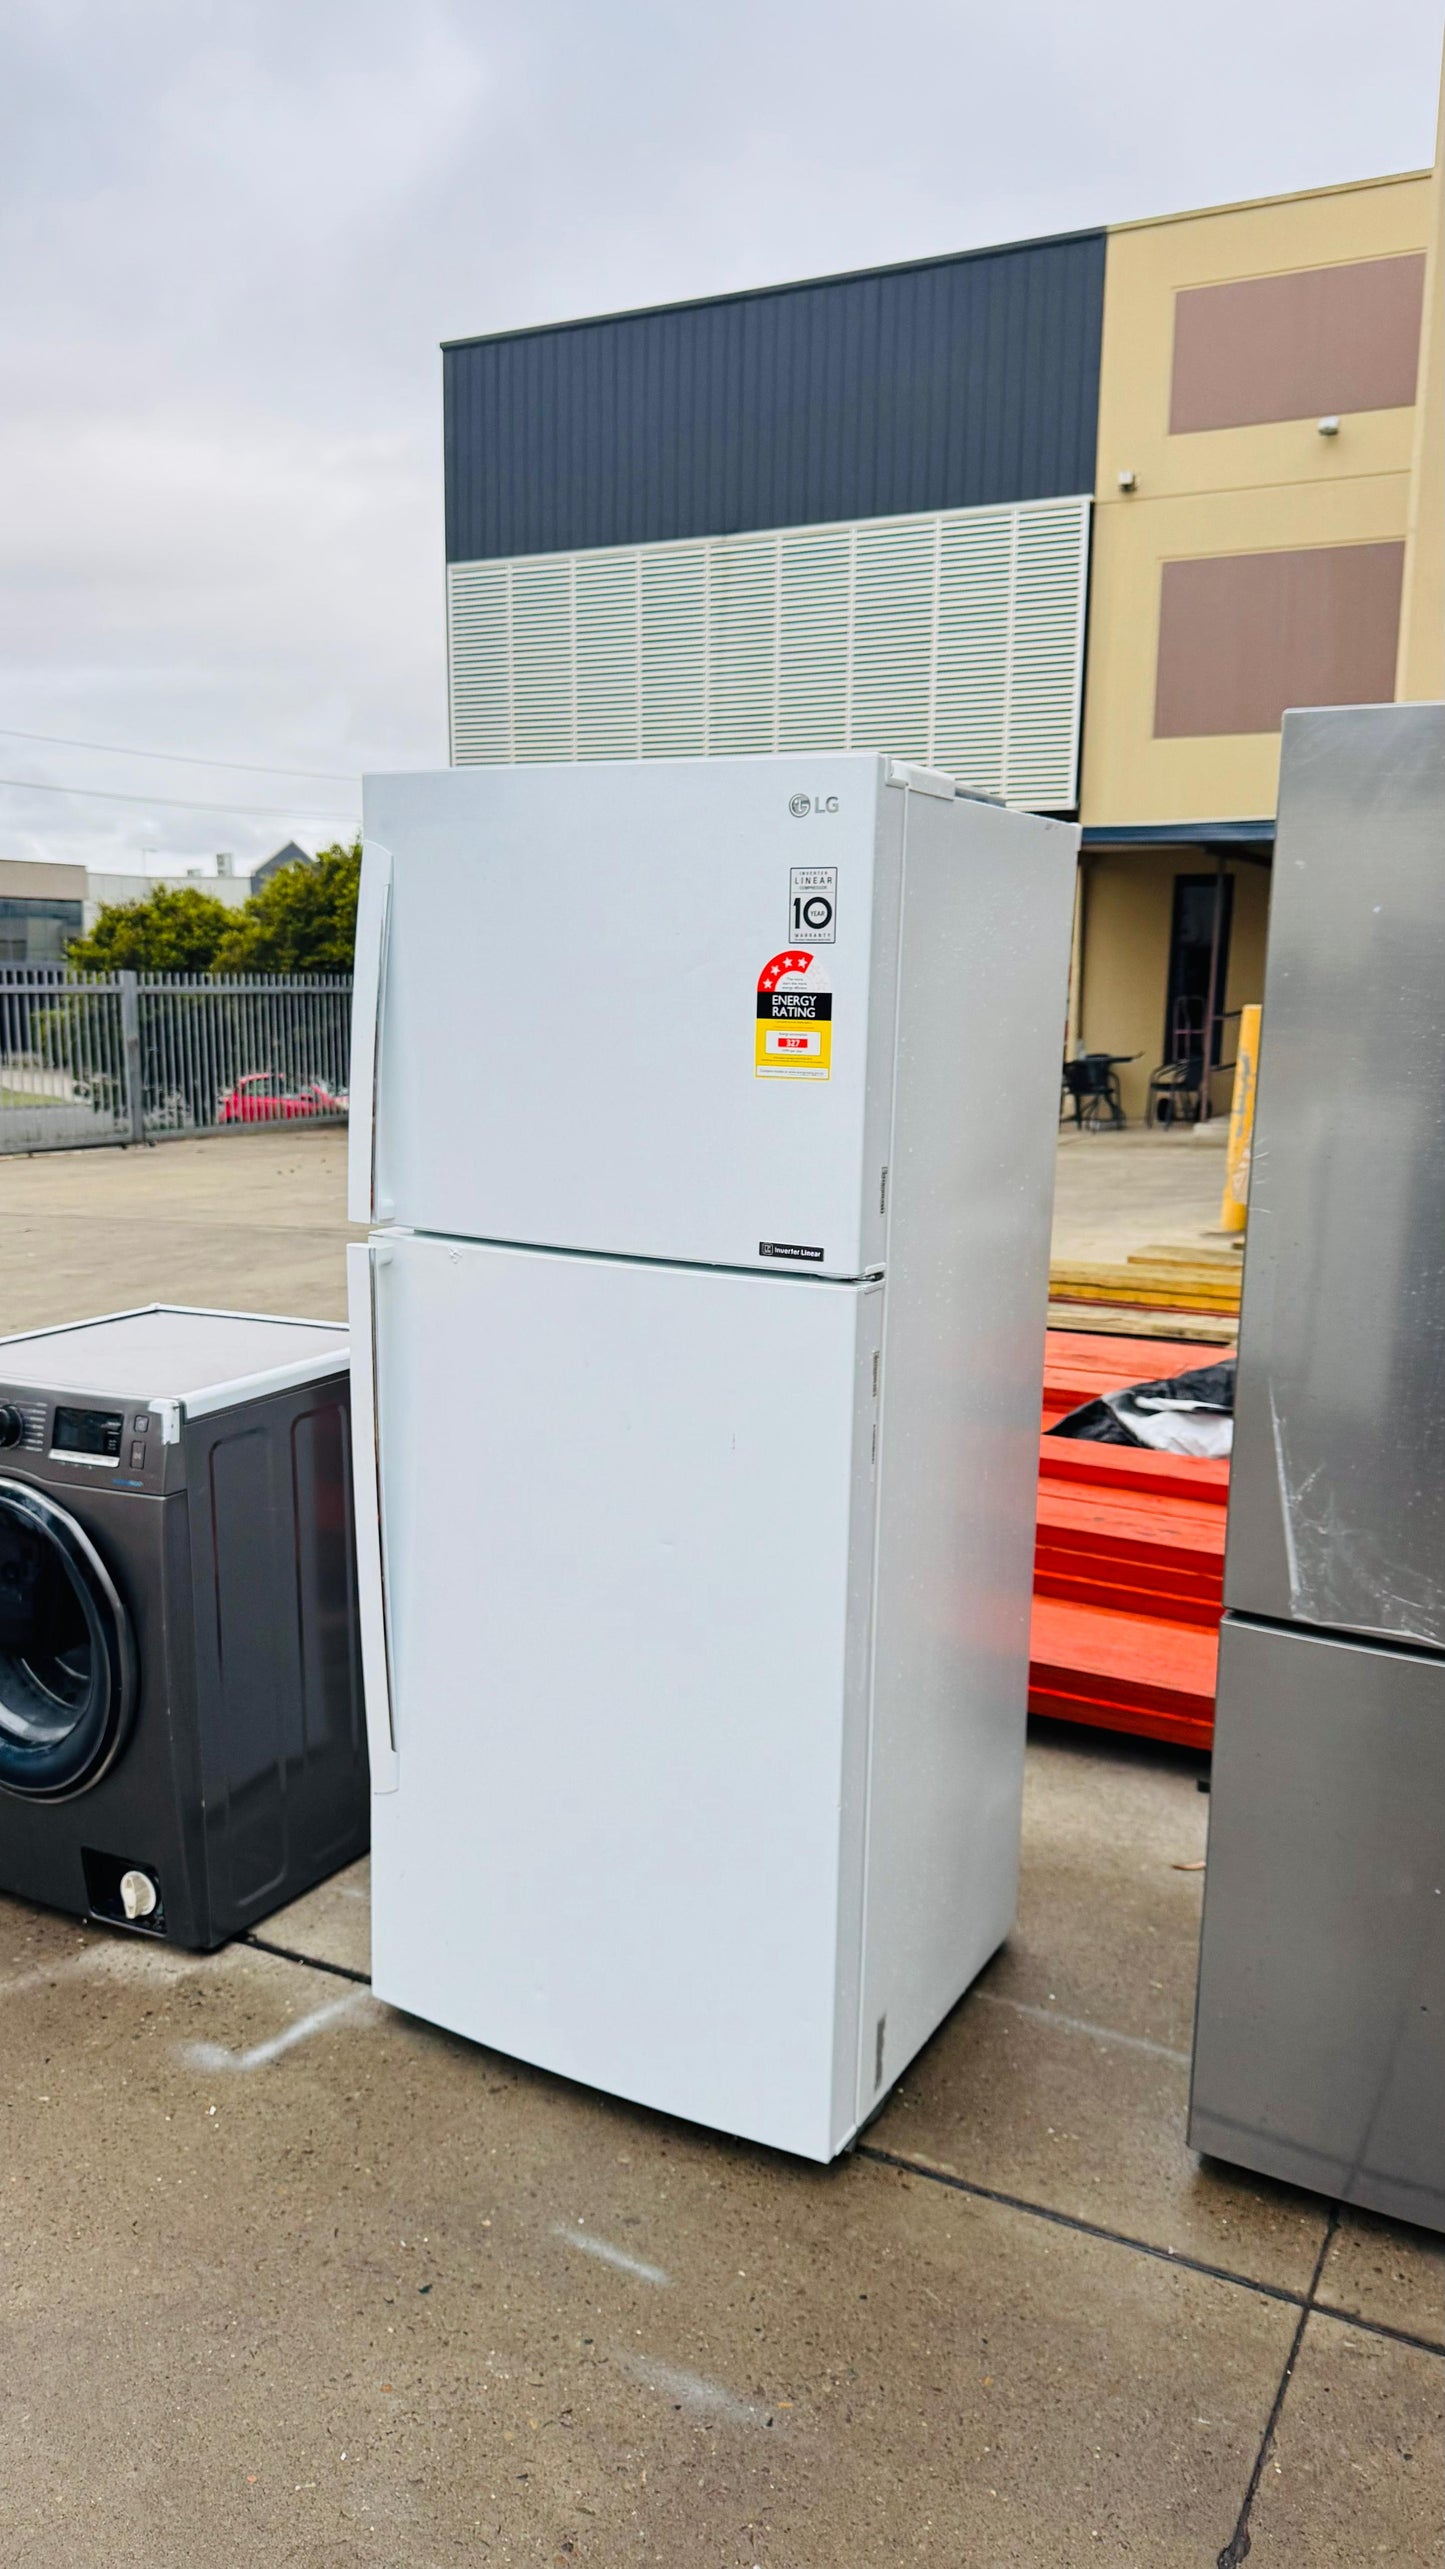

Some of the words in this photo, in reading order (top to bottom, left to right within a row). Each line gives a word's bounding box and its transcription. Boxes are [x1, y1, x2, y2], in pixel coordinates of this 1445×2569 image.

[814, 796, 839, 814] LG
[794, 876, 833, 885] LINEAR
[793, 896, 833, 930] 10
[772, 995, 816, 1006] ENERGY
[772, 1006, 815, 1017] RATING
[775, 1247, 800, 1256] Inverter
[800, 1249, 821, 1257] Linear
